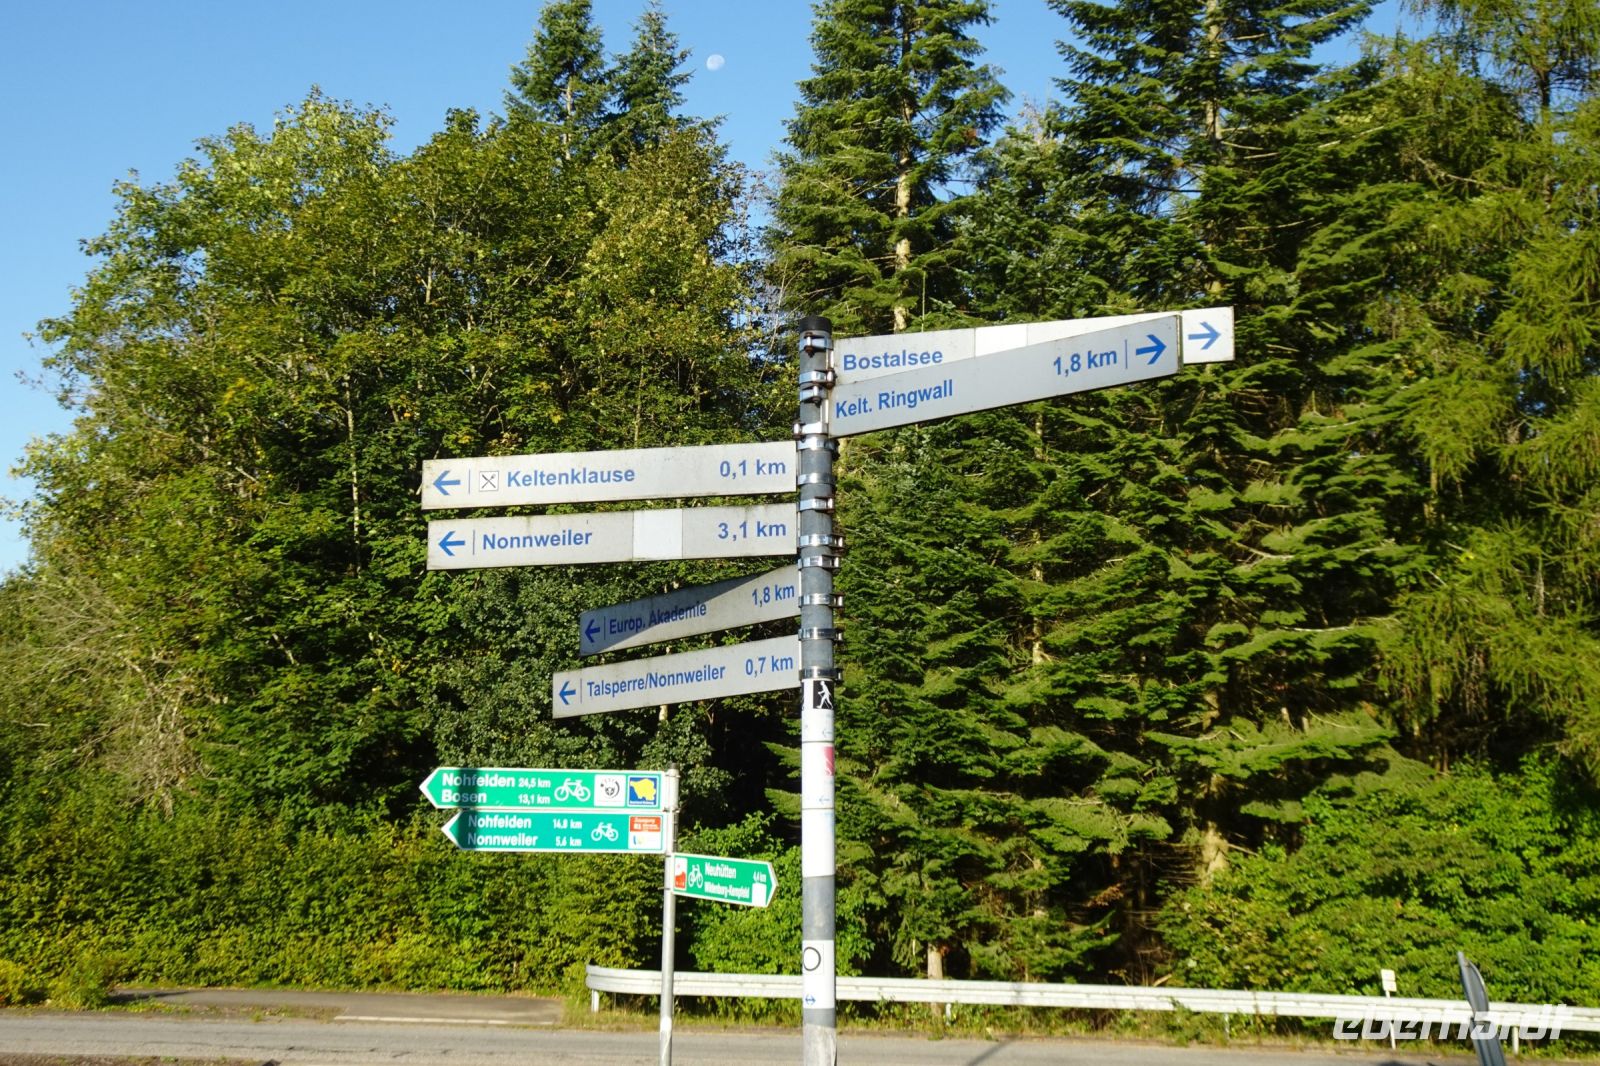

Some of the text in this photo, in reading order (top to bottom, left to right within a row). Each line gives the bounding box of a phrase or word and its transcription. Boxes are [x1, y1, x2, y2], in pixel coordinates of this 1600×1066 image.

[843, 351, 943, 371] Bostalsee
[1052, 350, 1118, 376] 1,8 km
[835, 379, 953, 419] Kelt. Ringwall
[507, 467, 635, 488] Keltenklause
[719, 458, 786, 480] 0,1 km
[483, 529, 592, 550] Nonnweiler
[718, 520, 787, 542] 3,1 km
[752, 583, 795, 608] 1,8 km
[609, 601, 707, 637] Europ. Akademie
[745, 655, 794, 678] 0,7 km
[587, 663, 726, 700] Talsperre/Nonnweiler
[442, 773, 515, 788] Nohfelden
[537, 778, 551, 788] km
[441, 790, 551, 805] Bosen 13,1 km
[469, 816, 531, 830] Nohfelden
[570, 819, 583, 829] km
[468, 834, 538, 848] Nonnweiler
[569, 836, 582, 847] km
